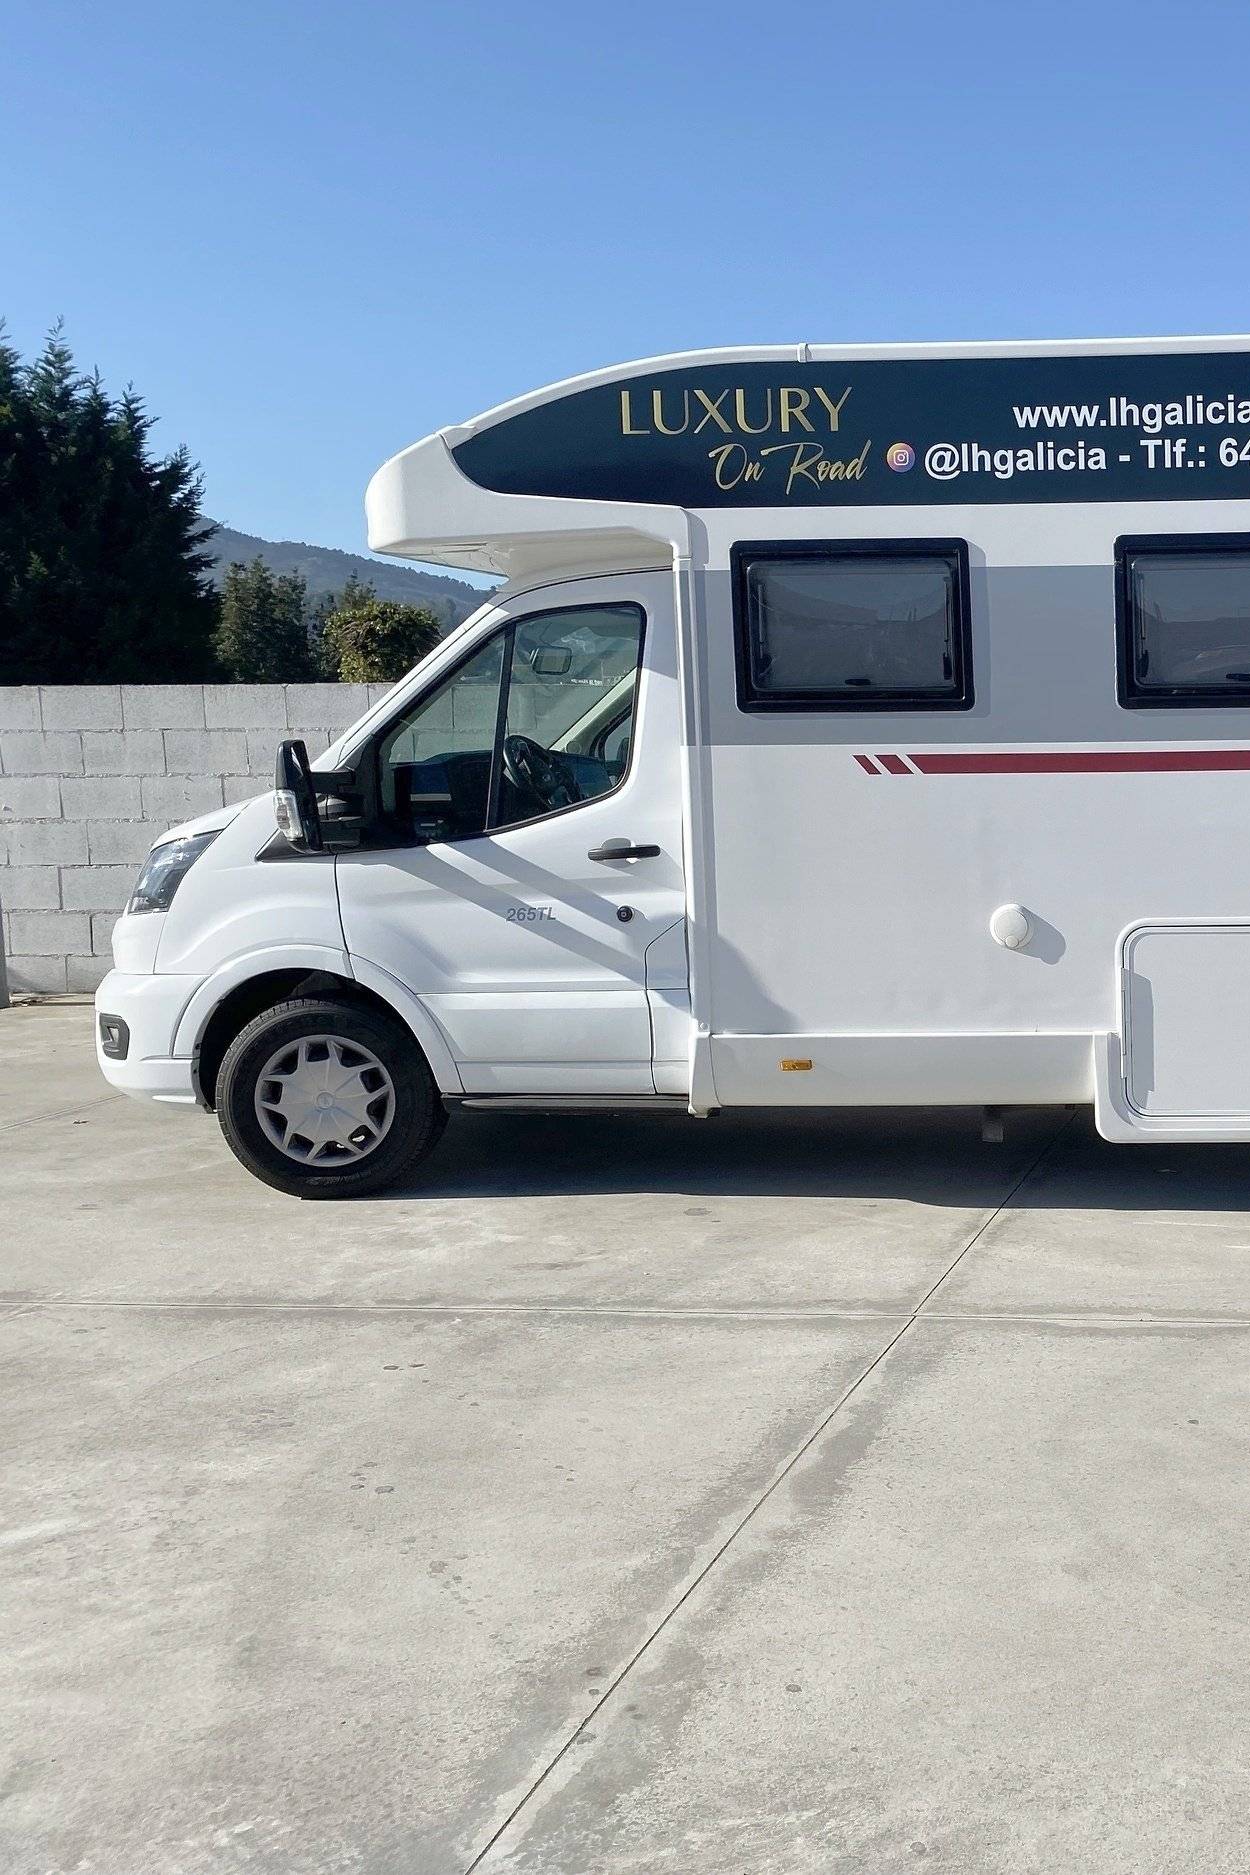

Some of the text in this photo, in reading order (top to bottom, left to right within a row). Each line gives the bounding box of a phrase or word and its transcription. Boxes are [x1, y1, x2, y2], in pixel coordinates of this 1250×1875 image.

[619, 386, 853, 436] LUXURY
[708, 439, 873, 496] On Road
[924, 440, 1107, 480] @lhgalicia
[1140, 437, 1206, 469] Tlf.:
[506, 907, 556, 921] 265TL
